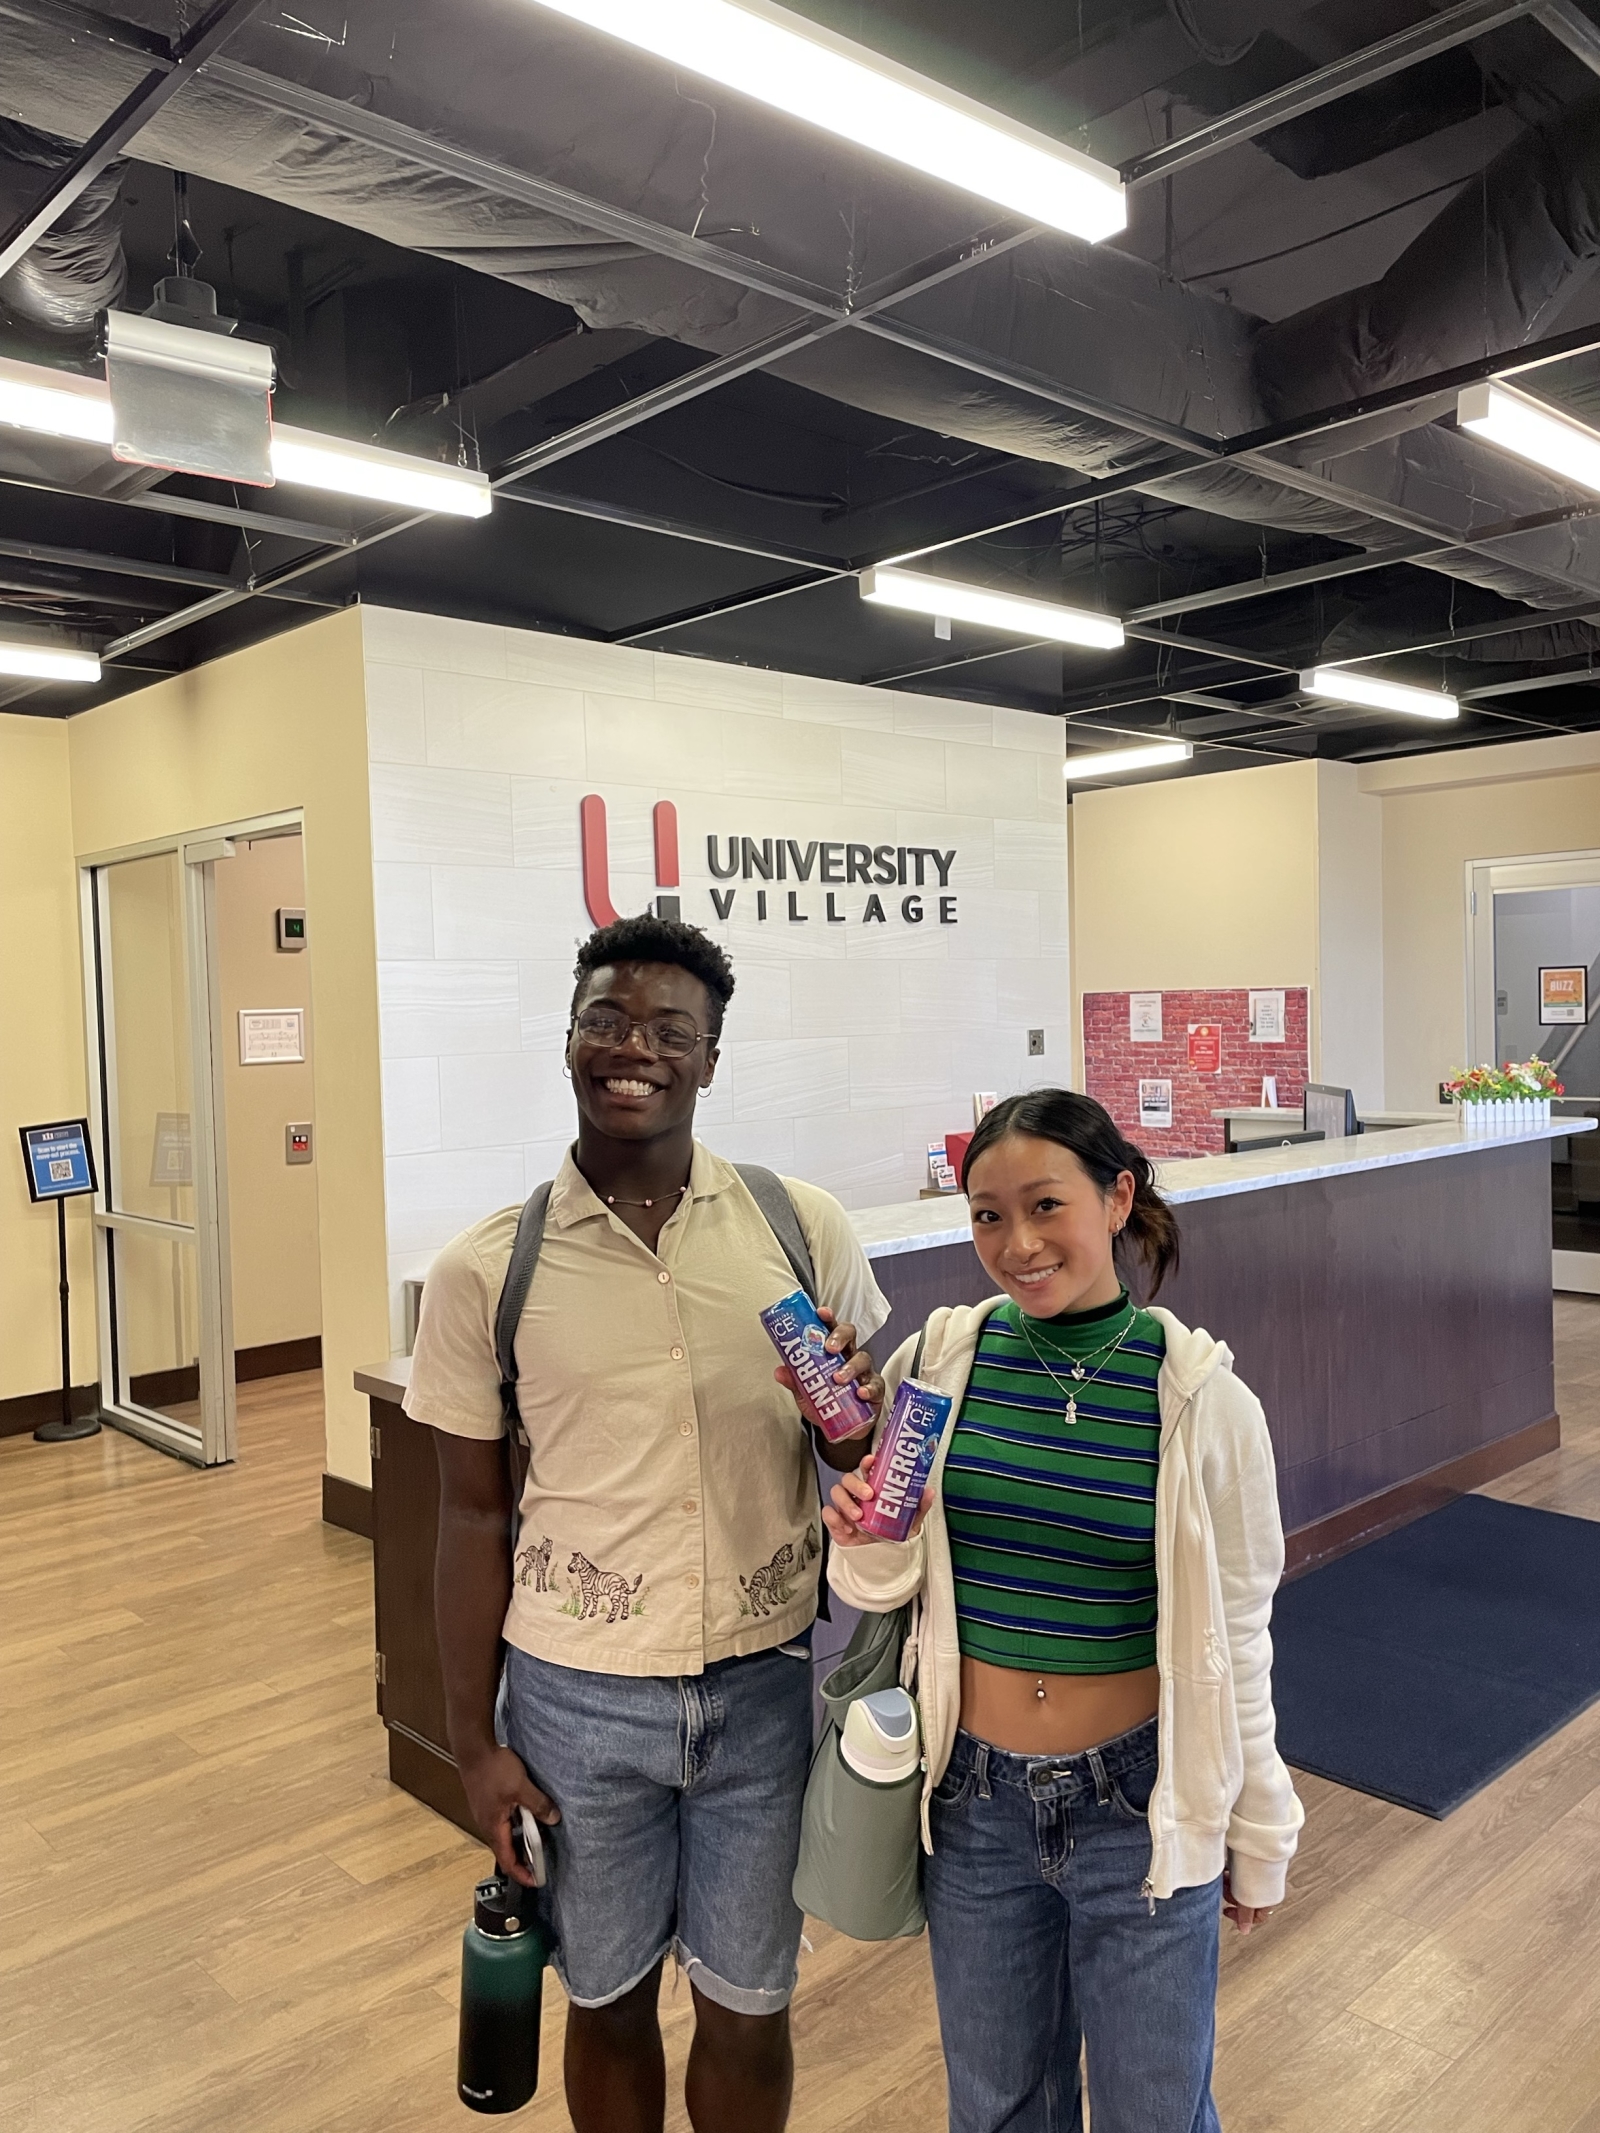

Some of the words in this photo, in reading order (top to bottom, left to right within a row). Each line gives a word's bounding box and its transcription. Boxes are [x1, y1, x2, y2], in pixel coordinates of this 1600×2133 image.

[706, 834, 957, 887] UNIVERSITY
[709, 888, 959, 924] VILLAGE
[1550, 980, 1573, 992] BUZZ
[770, 1316, 795, 1340] ICE
[780, 1337, 842, 1421] ENERGY
[903, 1405, 935, 1427] ICE
[875, 1421, 925, 1520] ENERGY
